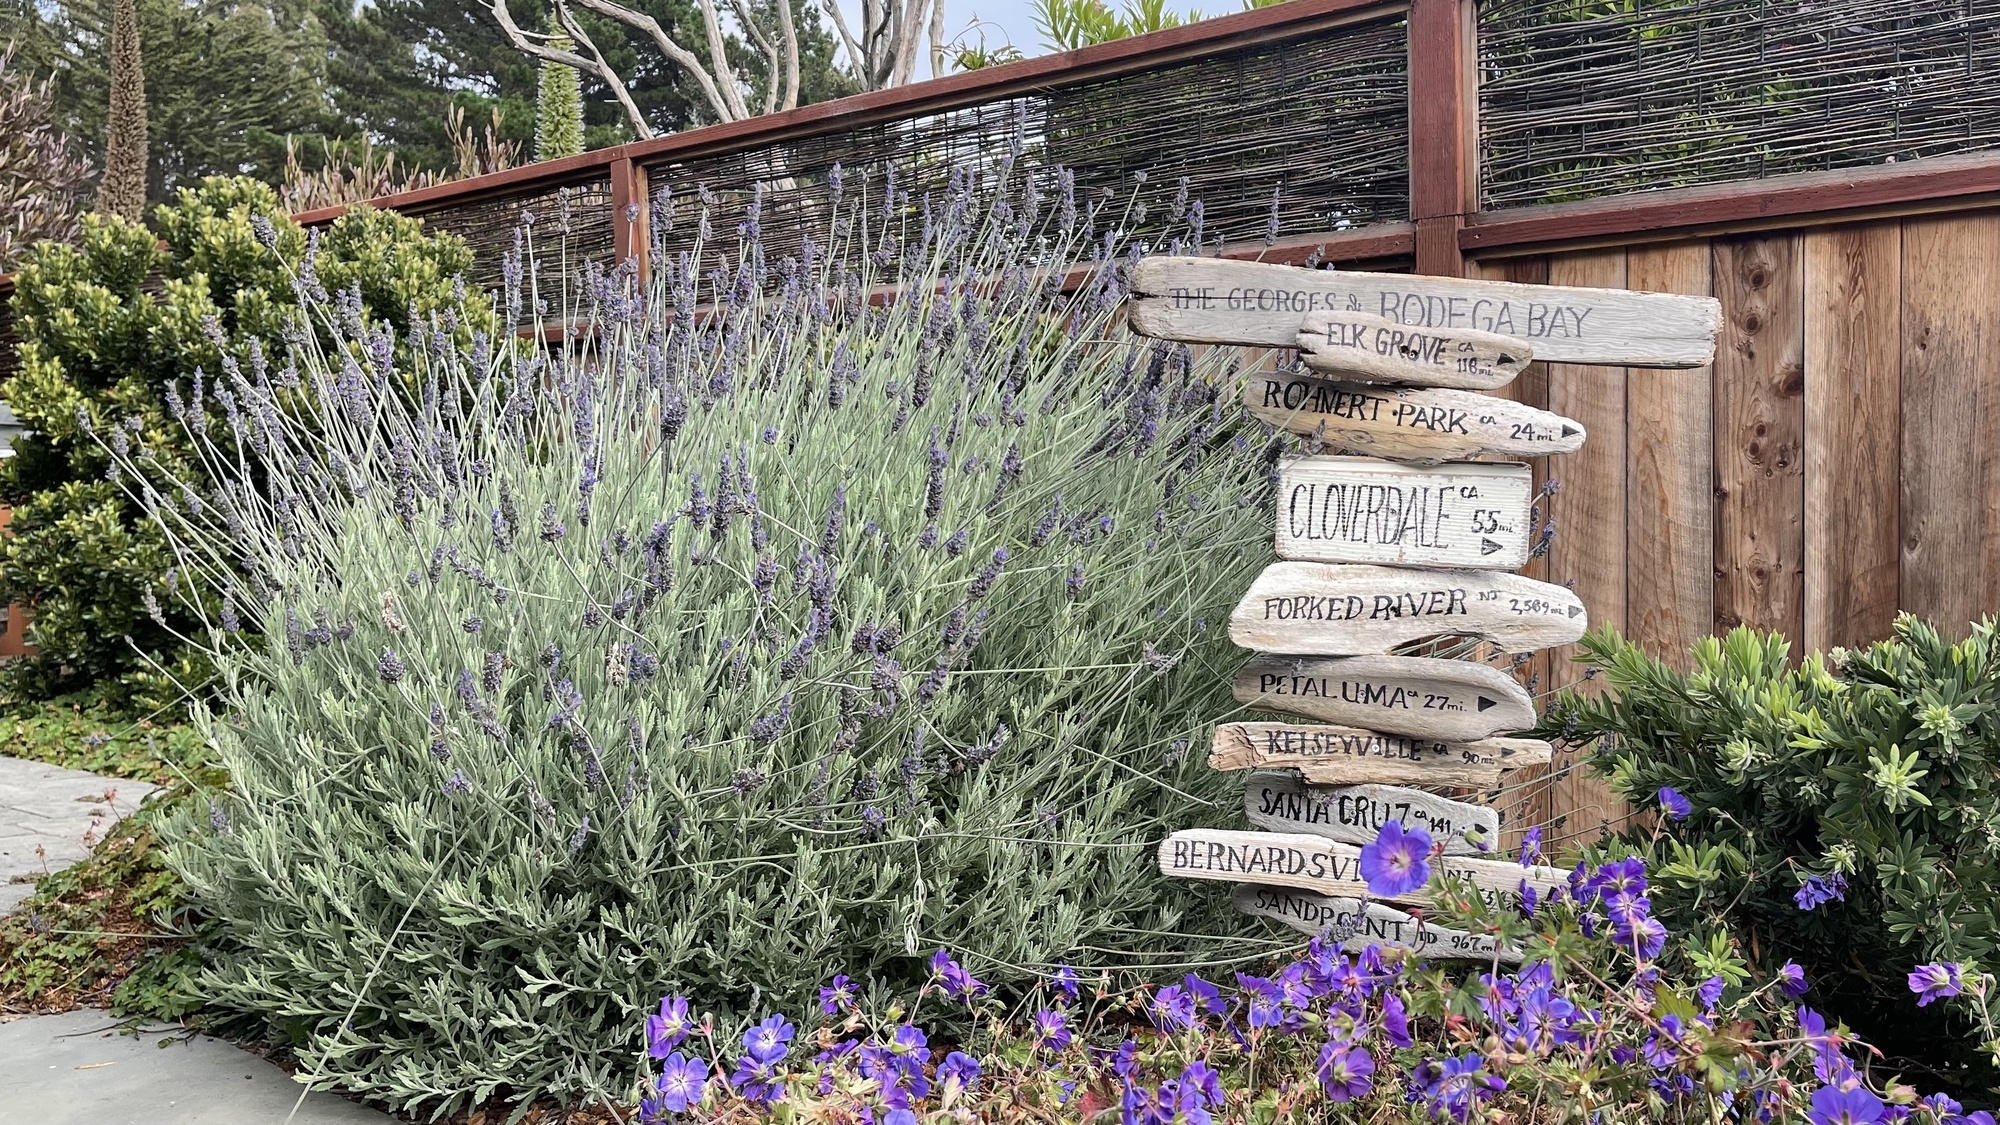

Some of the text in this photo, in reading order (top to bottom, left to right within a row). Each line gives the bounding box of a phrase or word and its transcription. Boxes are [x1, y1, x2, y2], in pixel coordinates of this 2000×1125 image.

[1169, 286, 1593, 338] THE GEORGES & BODEGA BAY
[1327, 322, 1475, 366] ELK GROVE CA
[1262, 380, 1389, 421] ROHNERT
[1396, 402, 1468, 435] PARK
[1289, 483, 1455, 549] CLOVERDALE
[1264, 596, 1363, 621] FORKED
[1372, 589, 1467, 620] RIVER
[1260, 673, 1408, 709] PETALUMA
[1407, 690, 1419, 698] CA
[1265, 730, 1424, 762] KELSEYVILLE
[1433, 742, 1449, 756] CA
[1258, 787, 1331, 825] SANTA
[1414, 809, 1428, 821] CA
[1173, 840, 1362, 883] BERNARDSVI
[1254, 888, 1409, 942] SANDPONT
[1420, 930, 1437, 944] ID
